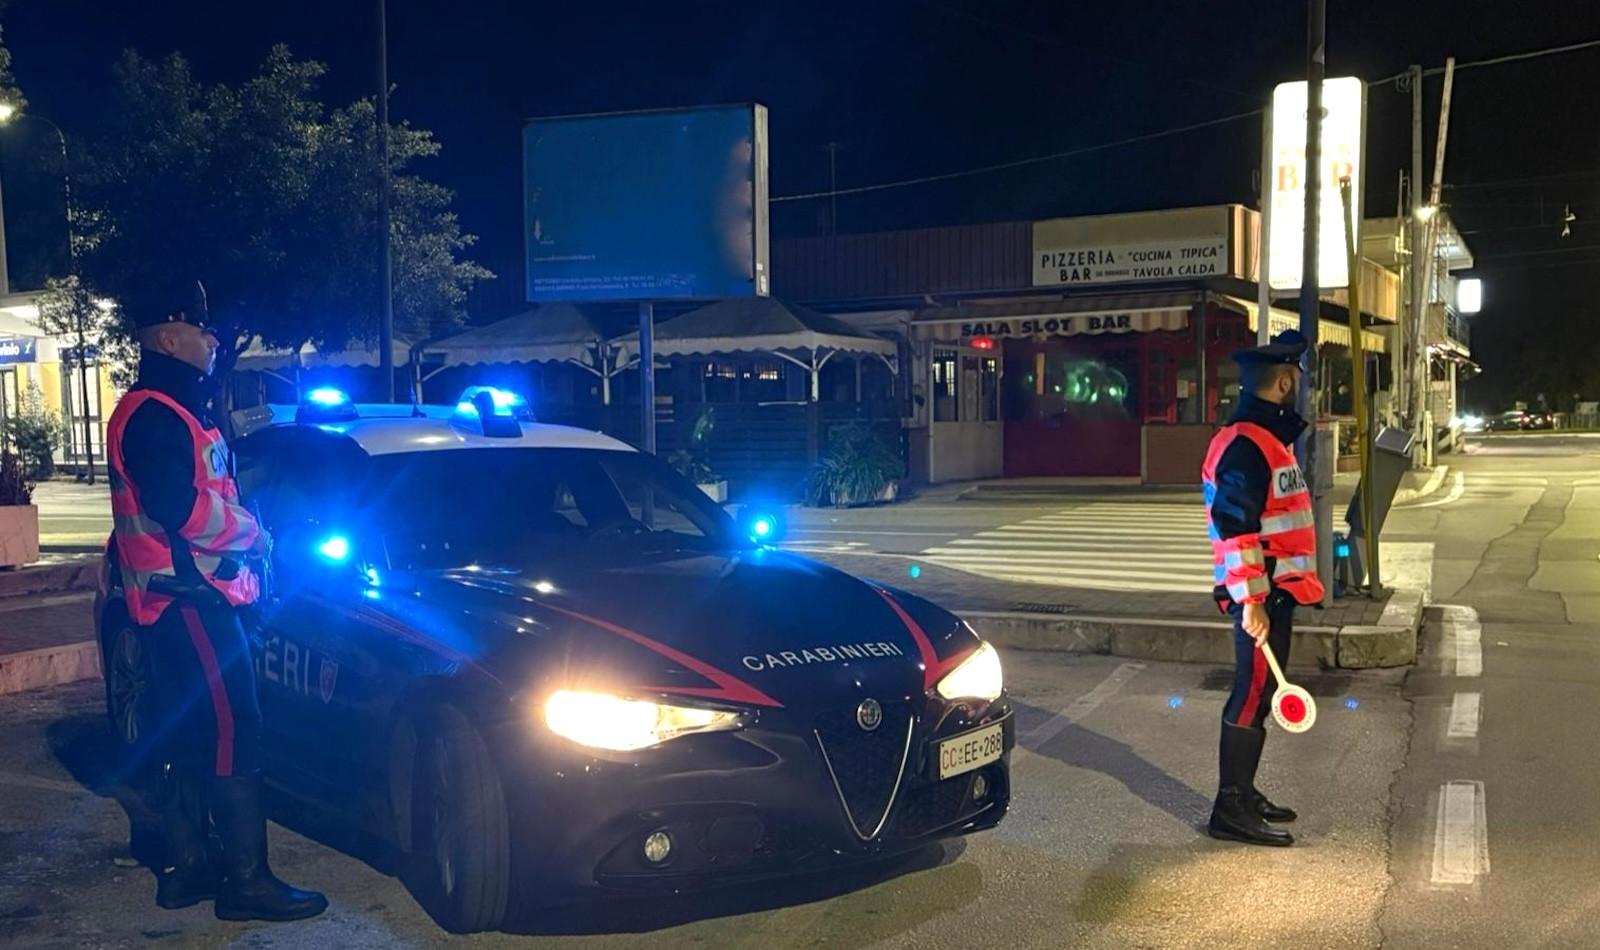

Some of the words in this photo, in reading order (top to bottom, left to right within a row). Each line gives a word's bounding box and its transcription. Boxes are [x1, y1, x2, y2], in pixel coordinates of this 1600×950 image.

[1277, 161, 1353, 192] BR
[1042, 250, 1115, 268] PIZZERIA
[1060, 268, 1092, 282] BAR
[1133, 266, 1174, 278] TAVOLA
[1177, 263, 1216, 276] CALDA
[961, 321, 1012, 337] SALA
[1021, 317, 1072, 334] SLOT
[1087, 315, 1132, 330] BAR
[742, 641, 904, 671] CARABINIERI
